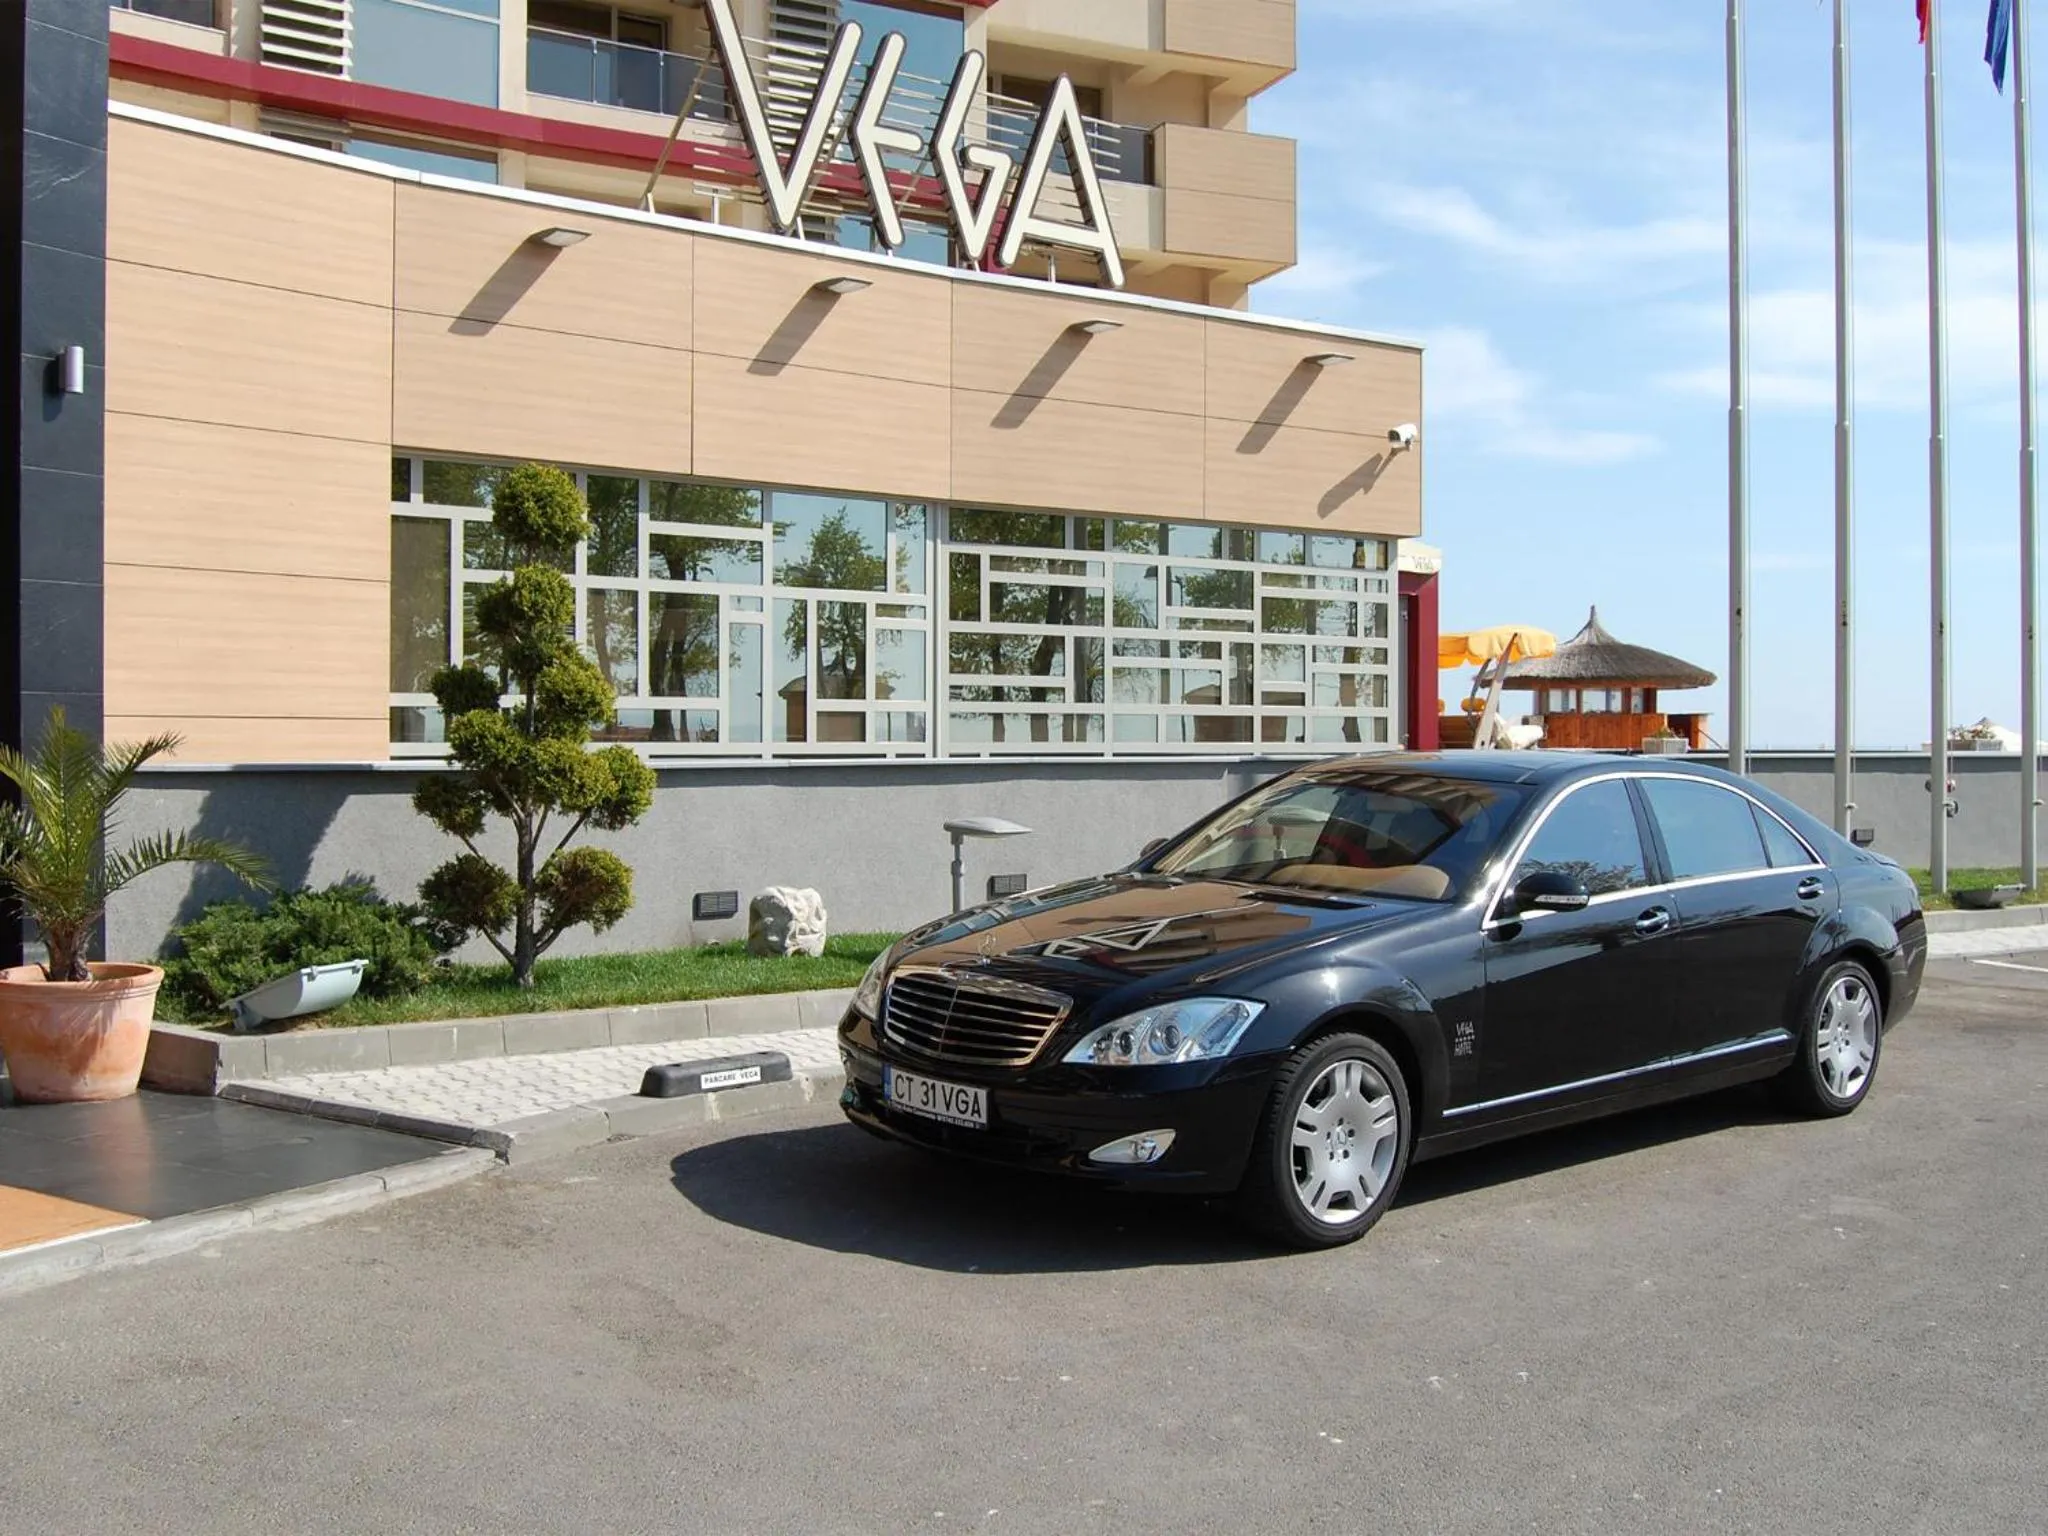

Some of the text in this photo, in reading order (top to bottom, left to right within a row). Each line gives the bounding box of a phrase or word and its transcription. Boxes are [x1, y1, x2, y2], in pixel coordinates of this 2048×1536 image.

[706, 0, 1125, 289] VEGA
[895, 1073, 914, 1102] CT
[920, 1081, 937, 1109] 31
[941, 1084, 982, 1119] VGA
